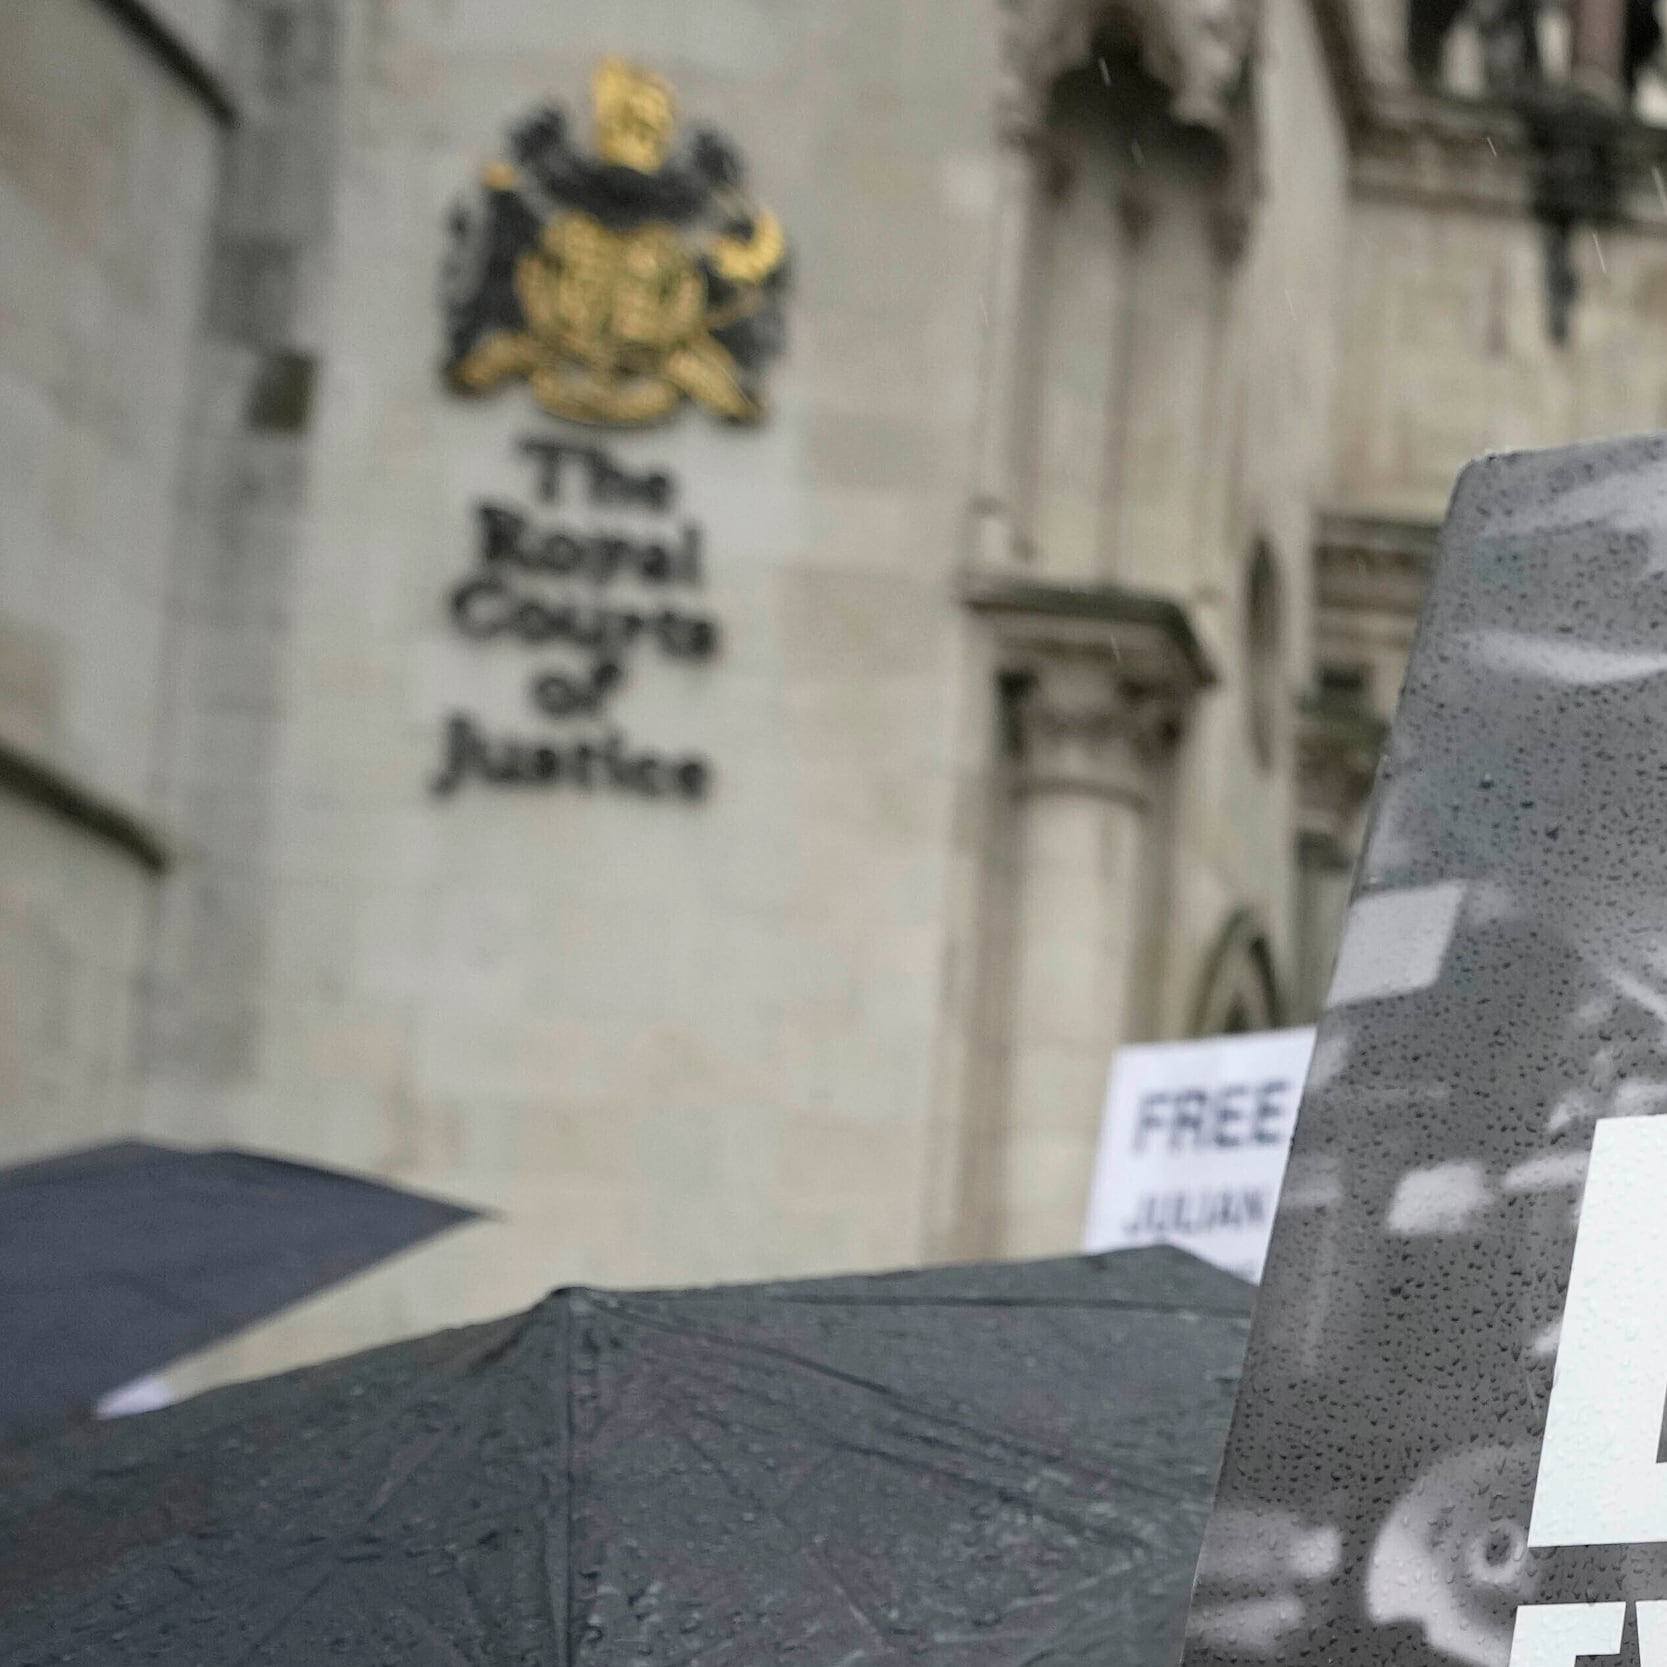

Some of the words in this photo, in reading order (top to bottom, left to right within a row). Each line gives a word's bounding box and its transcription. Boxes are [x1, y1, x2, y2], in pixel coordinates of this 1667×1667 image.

[518, 437, 674, 505] The
[476, 506, 700, 590] Royal
[453, 577, 717, 668] Courts
[529, 659, 626, 718] of
[431, 714, 711, 799] Justice
[1130, 1079, 1290, 1157] FREE
[1123, 1189, 1266, 1236] JULIAN
